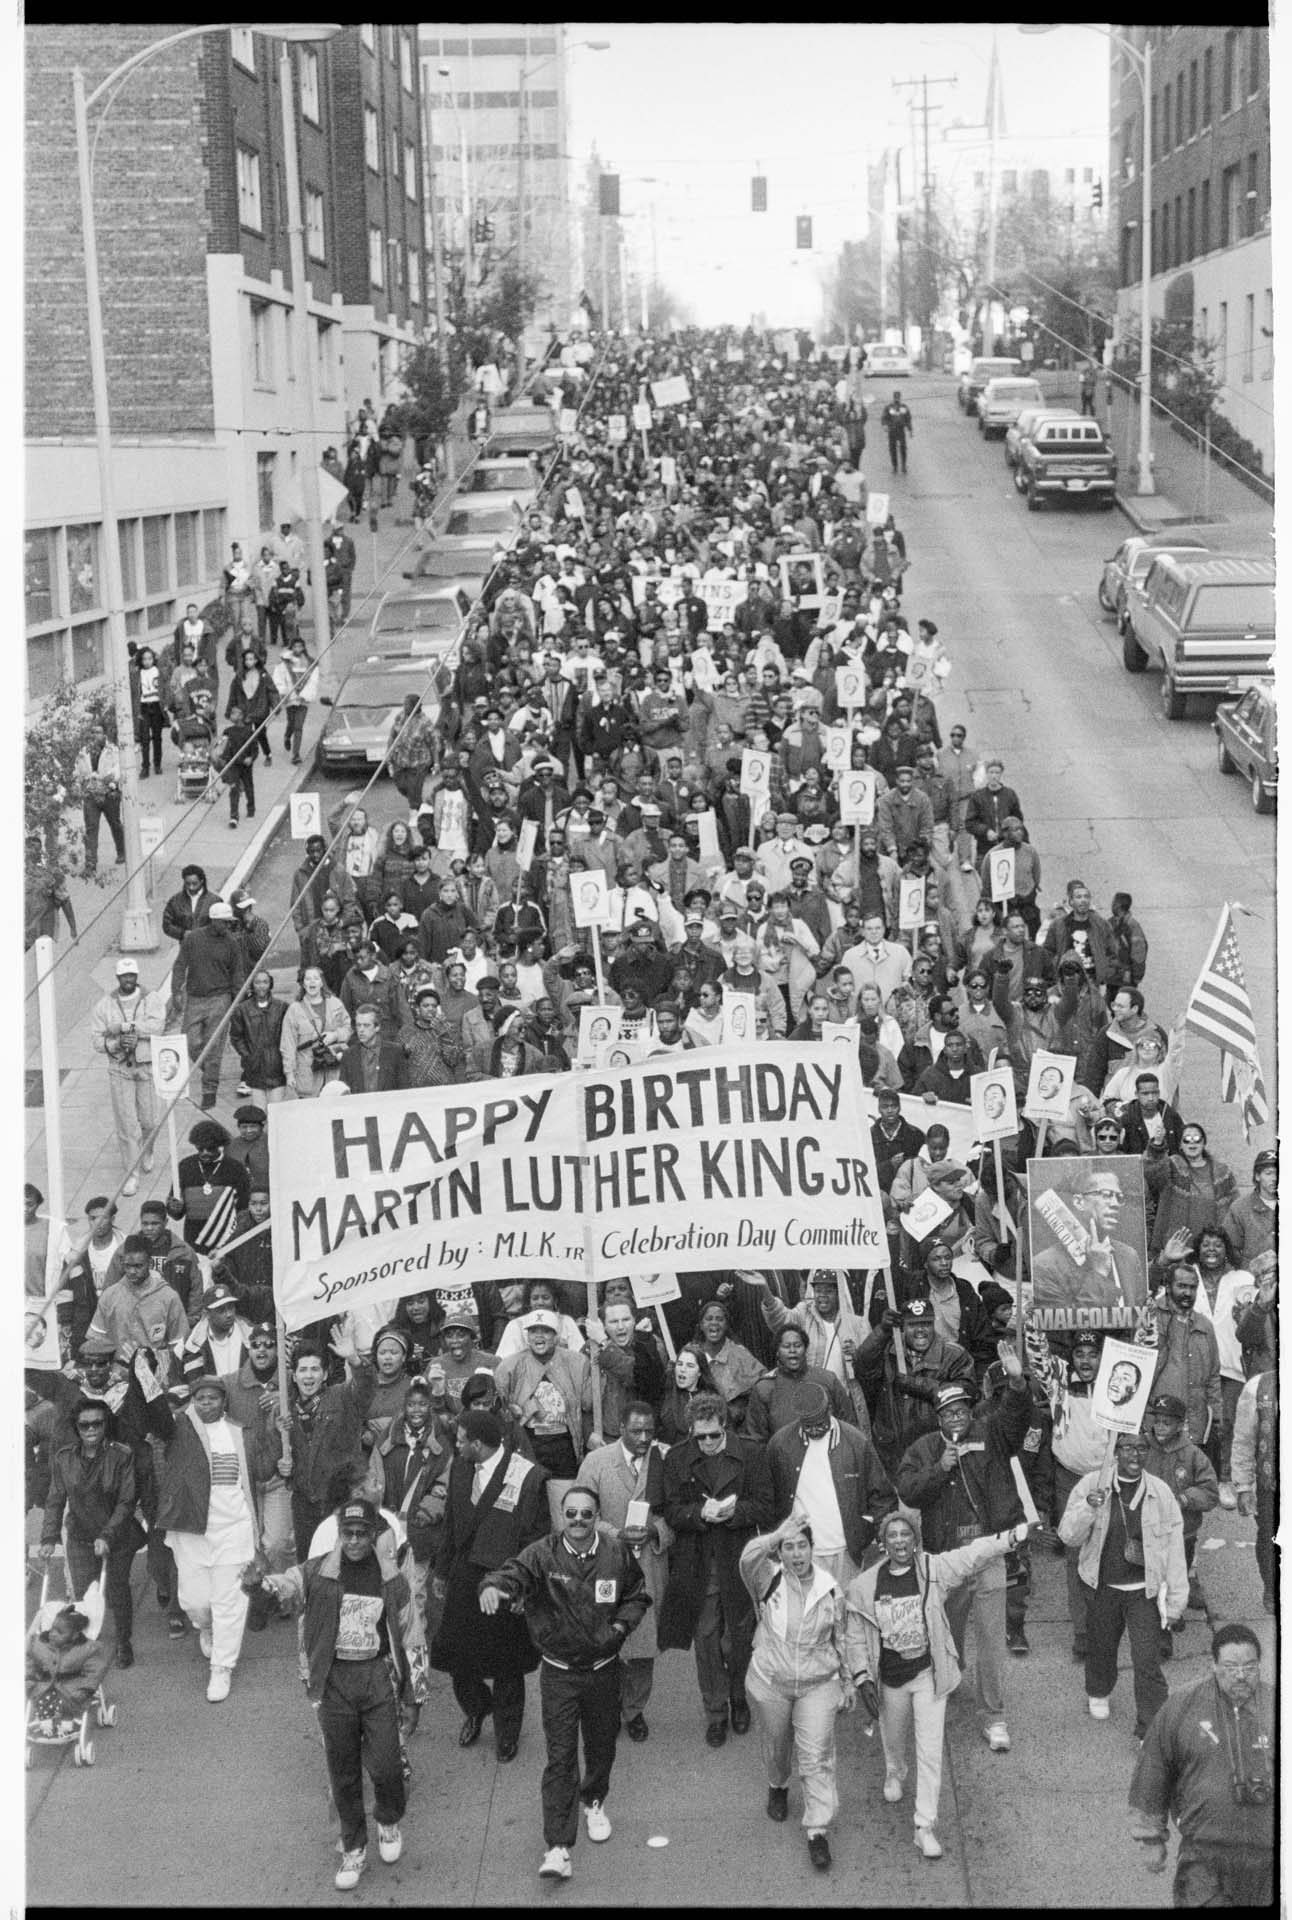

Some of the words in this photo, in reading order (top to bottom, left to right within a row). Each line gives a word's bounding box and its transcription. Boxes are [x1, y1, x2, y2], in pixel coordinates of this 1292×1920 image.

[331, 1089, 552, 1179] HAPPY
[584, 1063, 841, 1142] BIRTHDAY
[292, 1161, 482, 1261] MARTIN
[502, 1143, 686, 1213] LUTHER
[700, 1136, 824, 1200] KING
[832, 1158, 872, 1198] JR
[313, 1243, 432, 1303] Sponsored
[601, 1222, 728, 1259] Celebration
[737, 1219, 776, 1252] Day
[784, 1217, 880, 1247] Committee
[1032, 1306, 1133, 1330] MALCOLM
[1133, 1305, 1147, 1329] X
